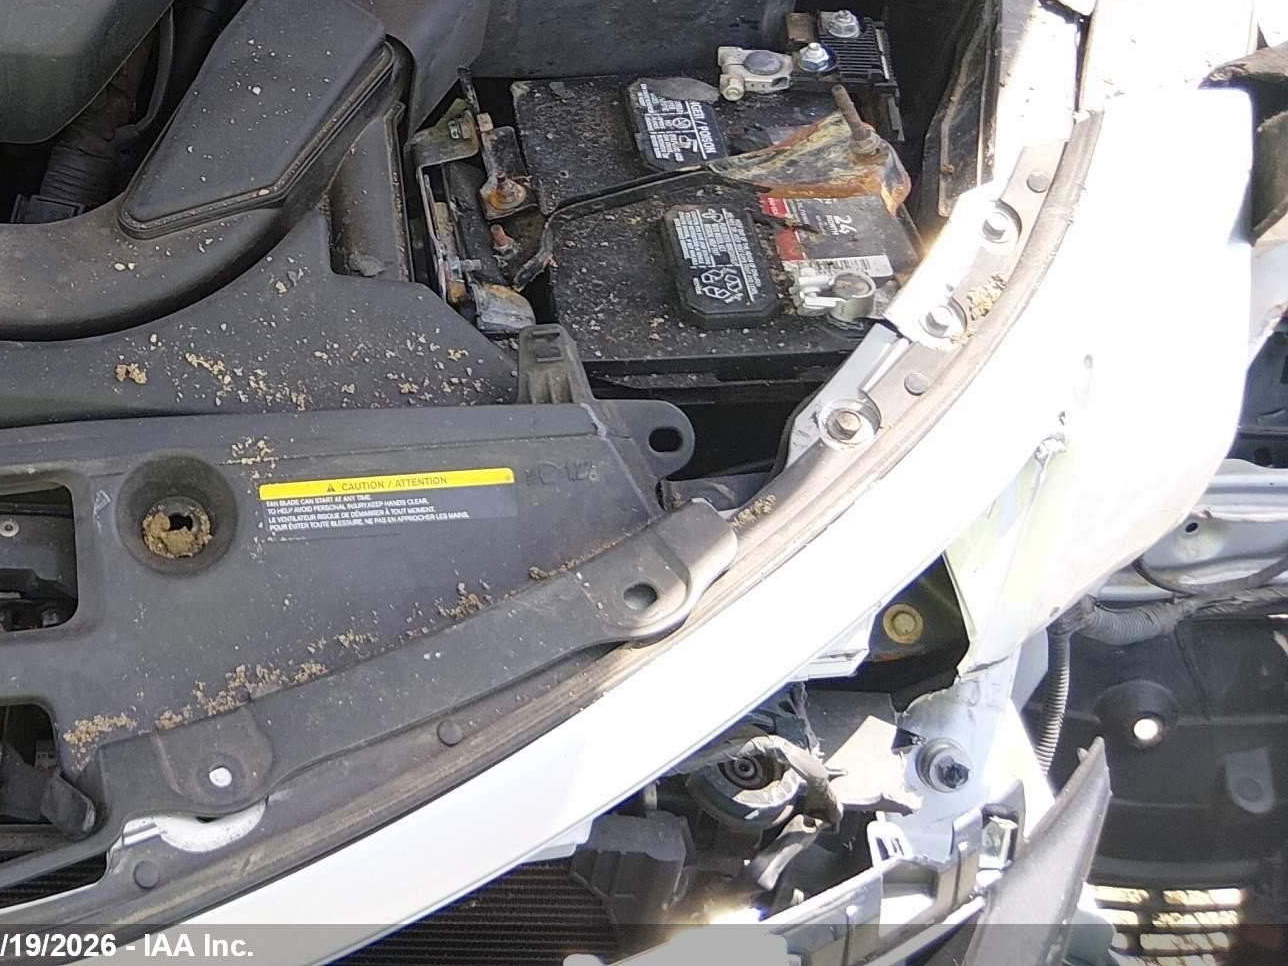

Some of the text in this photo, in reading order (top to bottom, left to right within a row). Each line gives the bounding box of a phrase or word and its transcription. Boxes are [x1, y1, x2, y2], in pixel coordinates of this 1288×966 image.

[697, 126, 717, 153] POISON
[825, 215, 839, 235] MONTH
[833, 215, 857, 234] 24
[342, 480, 384, 491] CAUTION
[396, 477, 447, 488] ATTENTION
[277, 514, 317, 523] VENTILATEUR
[317, 512, 339, 520] RISQUE
[351, 510, 384, 518] DÉMARRER
[314, 504, 347, 513] PERSONAL
[288, 522, 310, 530] ÉVITER
[310, 521, 330, 529] TOUTE
[397, 514, 436, 523] APPROCHER
[436, 513, 448, 521] LES
